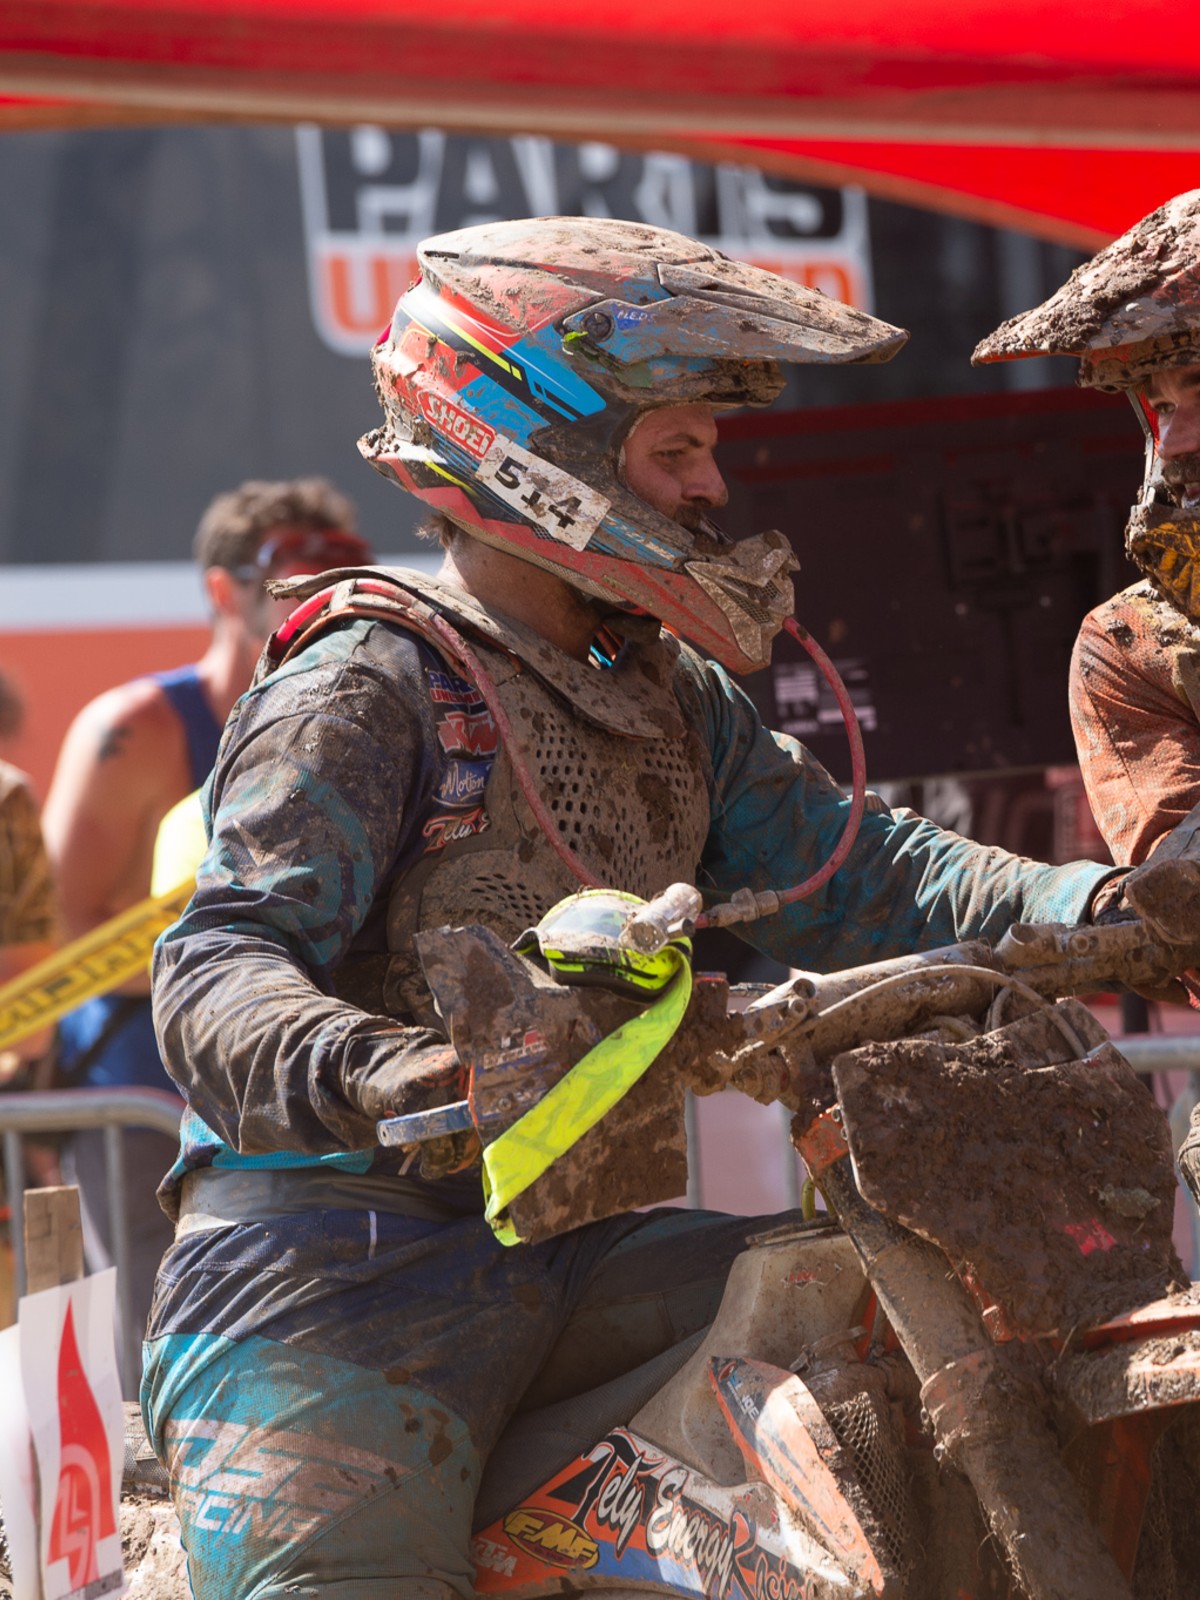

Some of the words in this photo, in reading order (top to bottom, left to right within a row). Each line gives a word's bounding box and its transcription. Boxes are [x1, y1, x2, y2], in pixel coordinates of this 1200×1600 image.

[426, 393, 493, 456] SHOEI
[494, 456, 582, 529] 514
[429, 670, 478, 693] PAR
[436, 711, 499, 756] KTM
[183, 1494, 321, 1541] ACING
[504, 1511, 600, 1560] FMF
[570, 1430, 668, 1562] Tely
[646, 1466, 735, 1600] Energy
[727, 1503, 816, 1600] Racin
